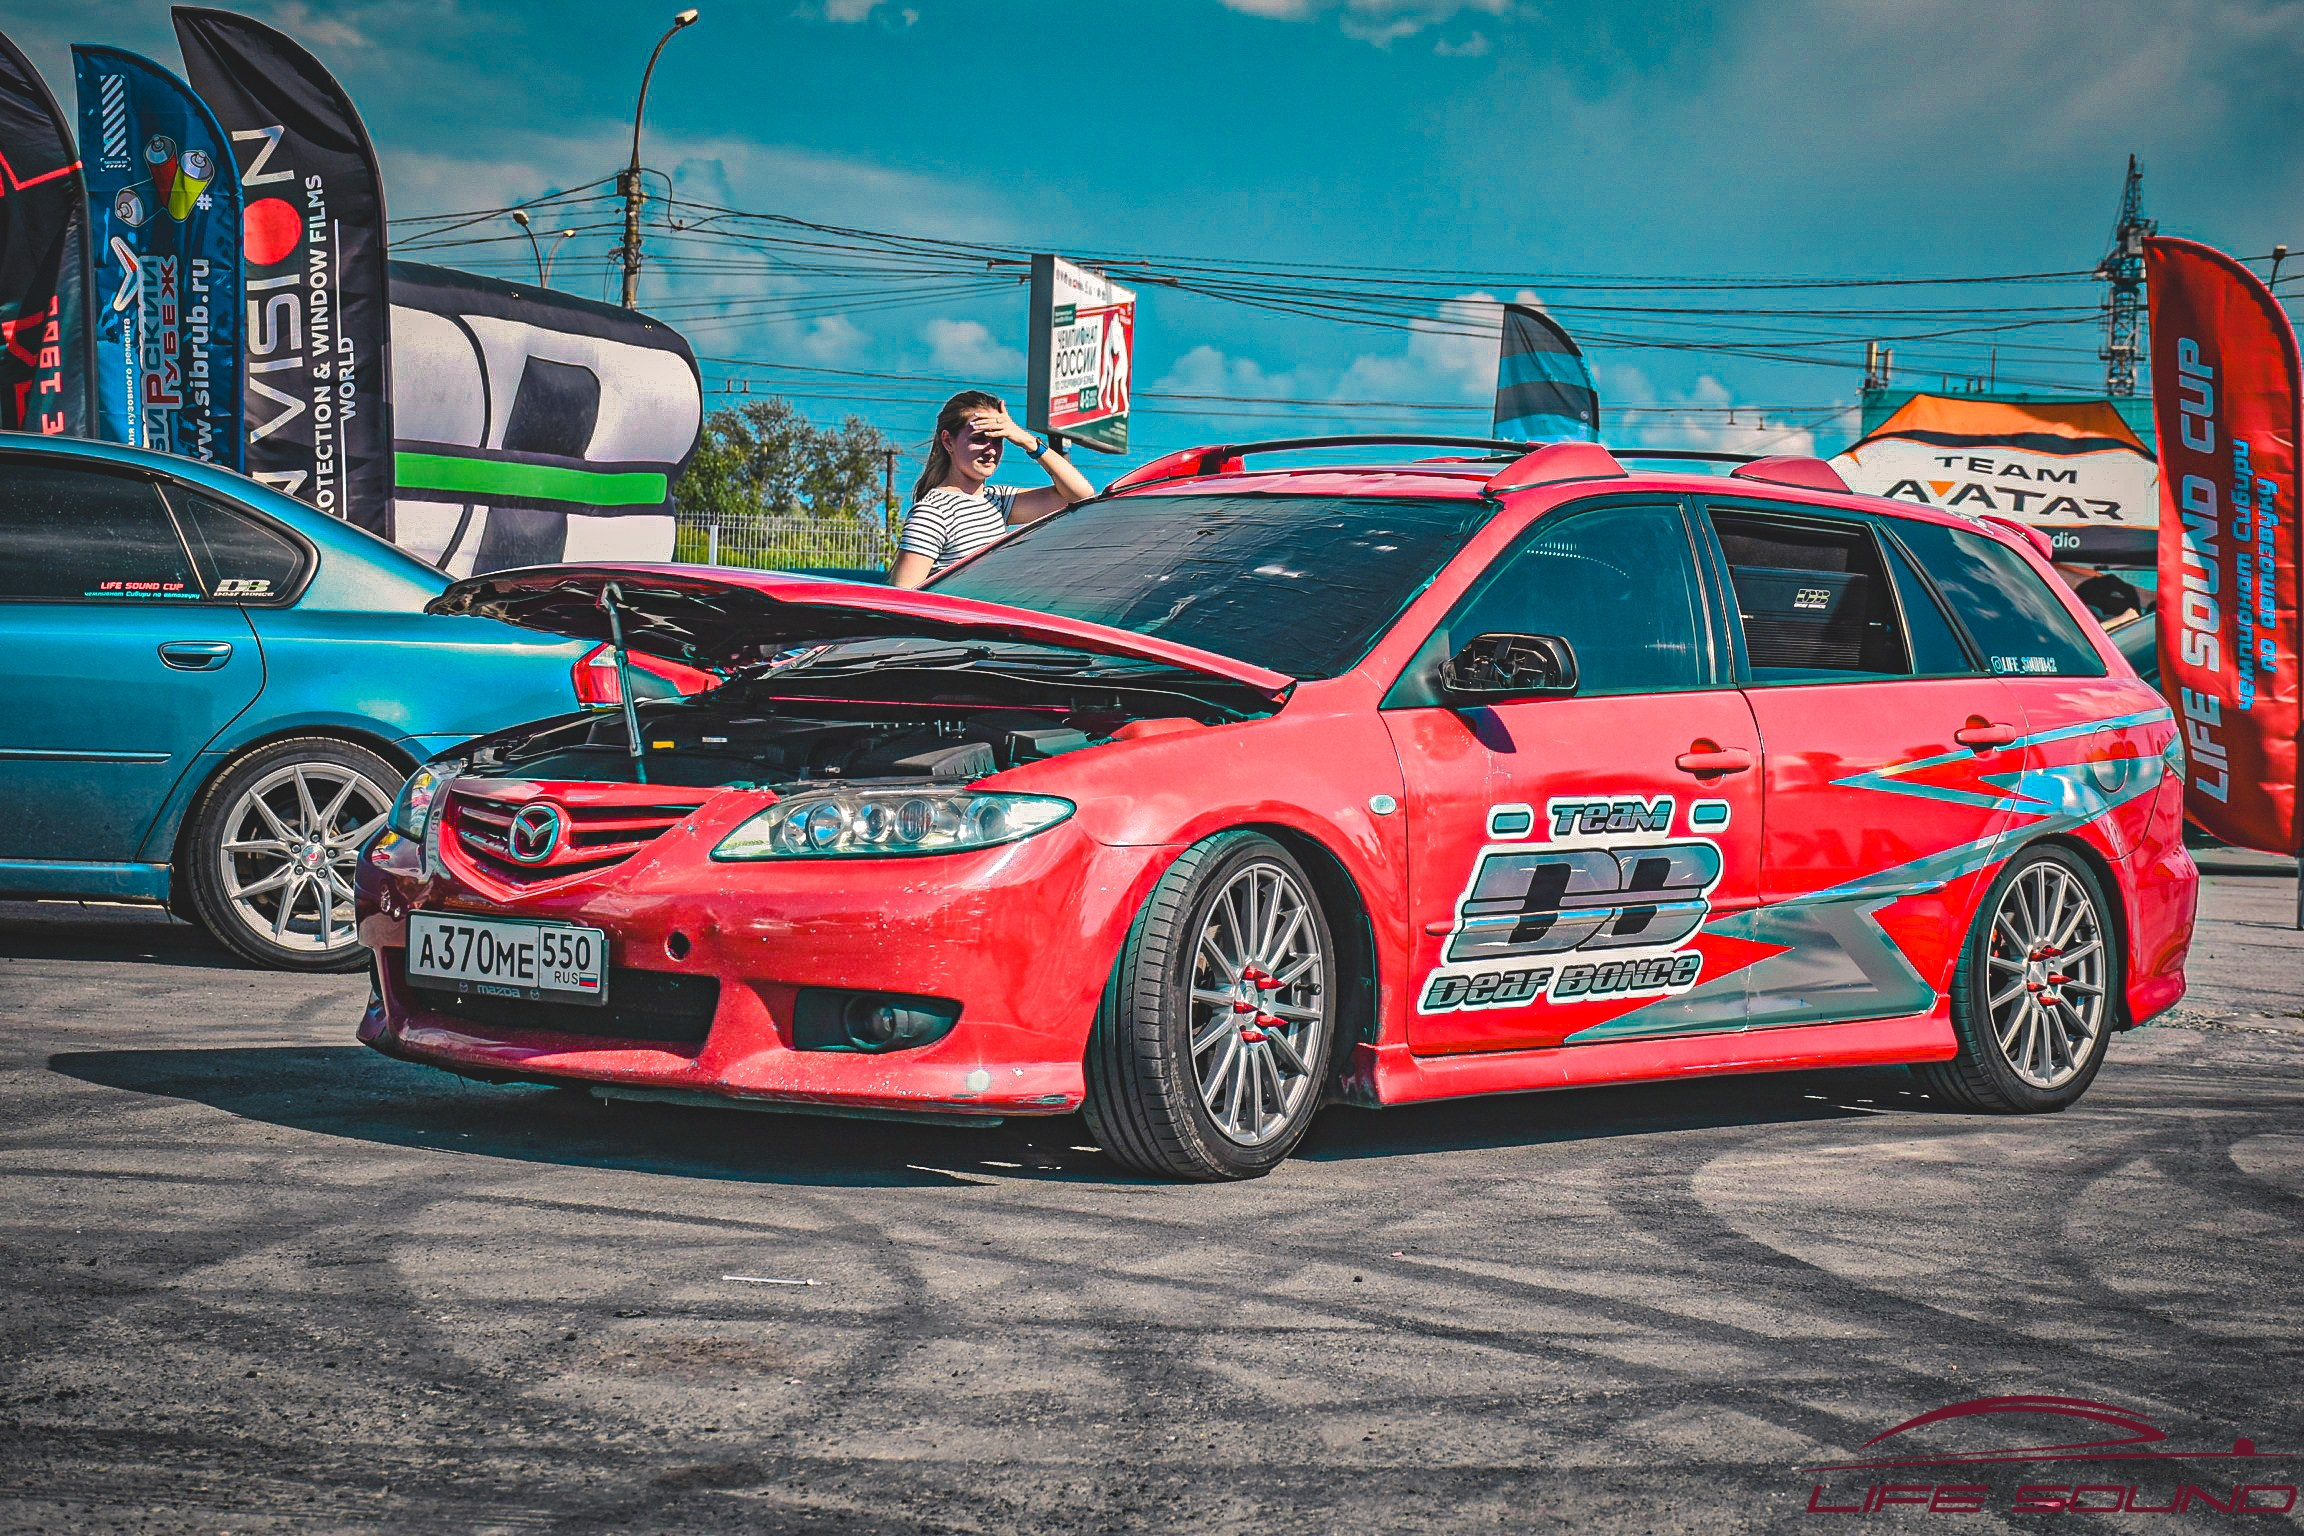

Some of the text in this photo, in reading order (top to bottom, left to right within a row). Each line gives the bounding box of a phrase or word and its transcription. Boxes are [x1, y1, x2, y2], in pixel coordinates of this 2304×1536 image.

[305, 174, 328, 243] FILMS
[309, 249, 330, 357] WINDOW
[123, 318, 134, 365] ремонта
[1057, 323, 1099, 349] ЧЕМПИОНАТ
[313, 361, 331, 379] &
[338, 337, 357, 421] WORLD
[1055, 346, 1097, 378] РОССИИ
[125, 368, 136, 425] кузовного
[1934, 456, 2078, 484] TEAM
[2231, 438, 2254, 542] Сибири
[1884, 480, 2124, 520] AVATAR
[100, 581, 184, 591] LIFE SOUND CUP
[2178, 337, 2229, 804] LIFE SOUND CUP
[2260, 638, 2277, 673] по
[1446, 841, 1722, 963] DB
[419, 925, 591, 979] A370ME 550
[554, 970, 579, 985] RUS
